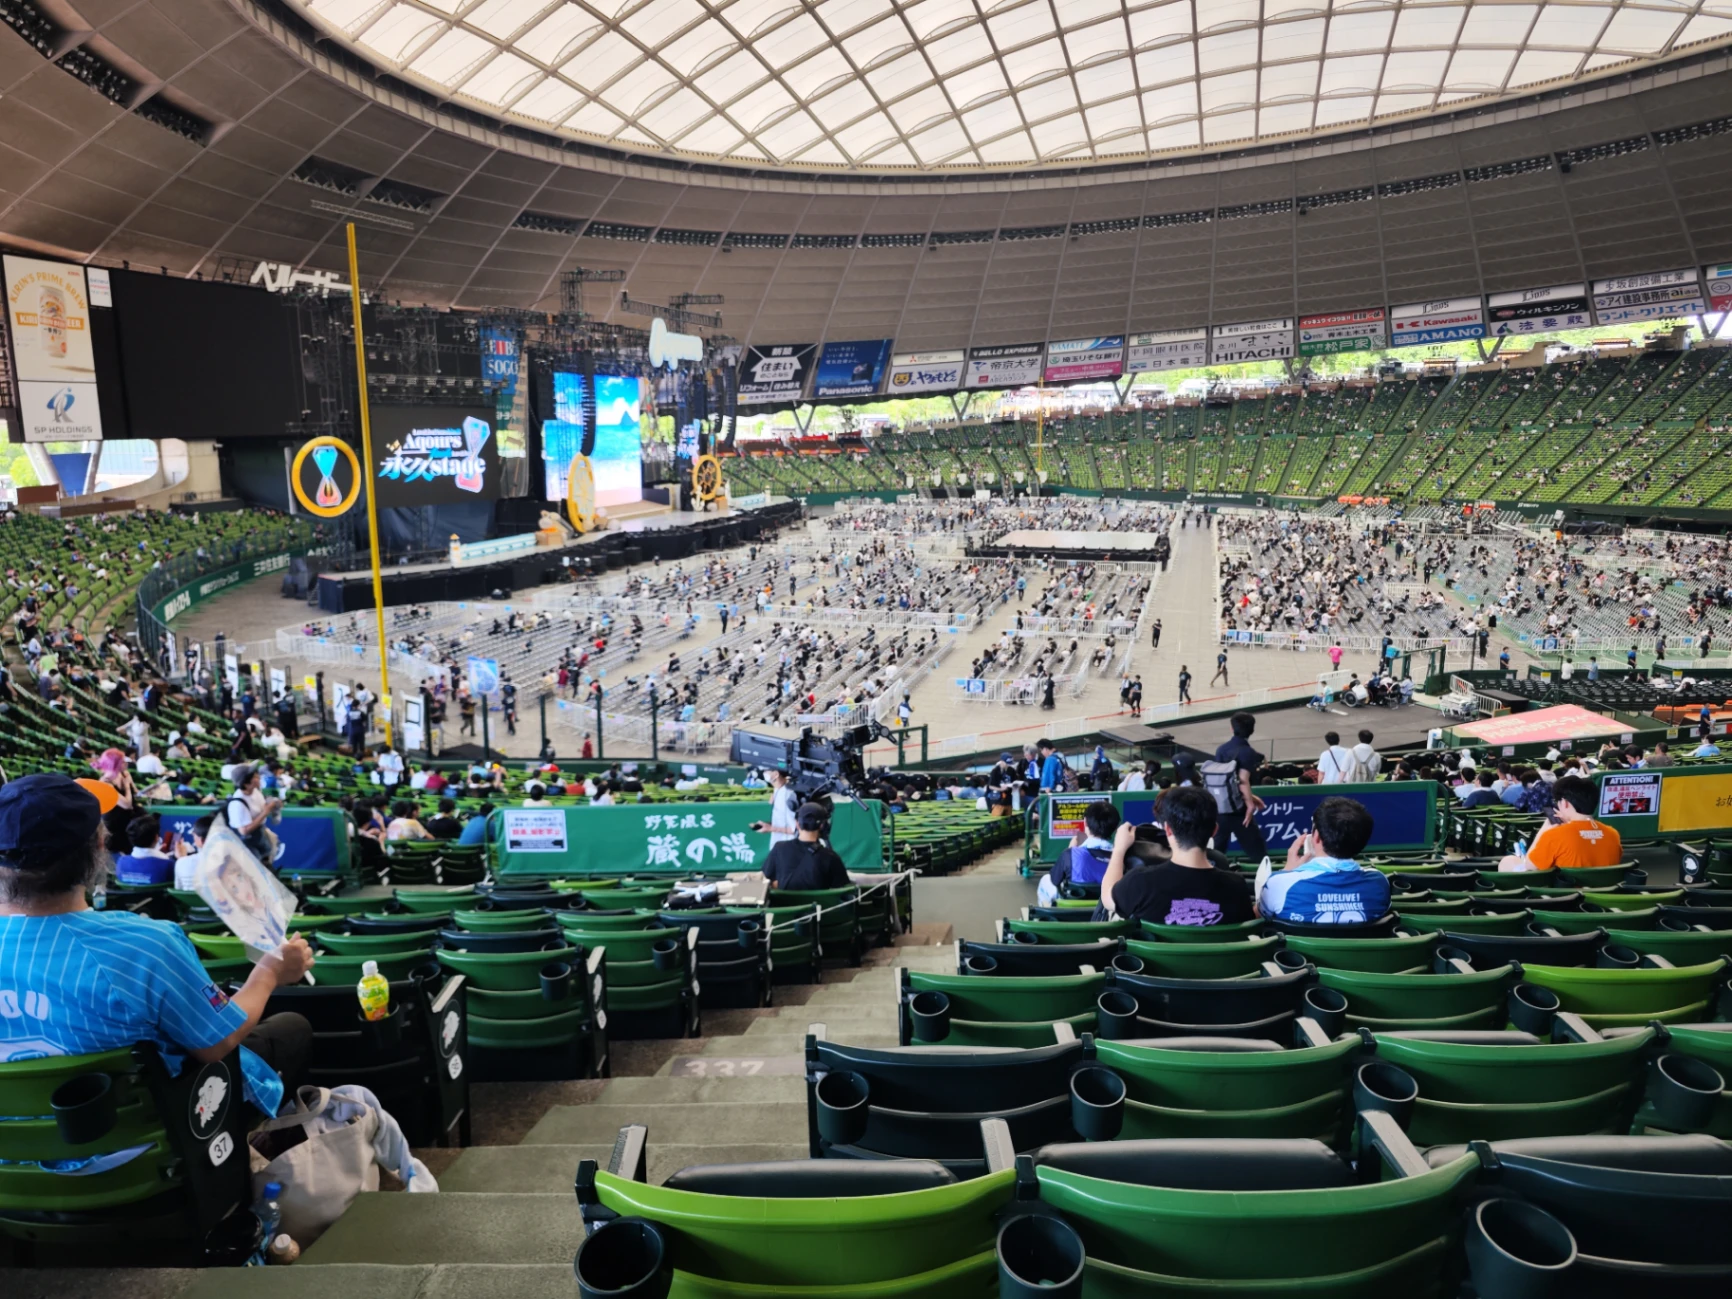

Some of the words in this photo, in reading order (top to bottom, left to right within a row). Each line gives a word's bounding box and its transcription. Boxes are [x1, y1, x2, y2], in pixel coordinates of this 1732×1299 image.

[10, 273, 35, 304] KIRIN'S
[36, 271, 63, 287] PRIME
[65, 282, 86, 310] BREW
[1516, 302, 1579, 315] ウィルキンソン
[1598, 302, 1704, 321] ランド・クリエイト
[1423, 314, 1478, 327] Kawasaki
[1518, 315, 1585, 331] 法要殿
[1420, 327, 1483, 341] AMANO
[1004, 346, 1038, 355] EXPRESS
[1215, 346, 1290, 362] HITACHI
[990, 358, 1038, 370] 帝京大学
[1062, 352, 1120, 363] 埼玉りそな銀行
[1152, 356, 1204, 368] 日本電工
[761, 362, 794, 372] 住まい
[818, 385, 873, 396] Panasonic
[34, 426, 47, 434] SP
[49, 426, 93, 434] HOLDINGS
[402, 433, 463, 453] Aqours
[1610, 776, 1654, 785] ATTENTION!
[644, 813, 716, 831] 野天風呂
[645, 832, 756, 868] 蔵の湯
[1317, 893, 1360, 902] LOVELIVE!
[684, 1060, 764, 1077] 337
[214, 1136, 227, 1158] 37
